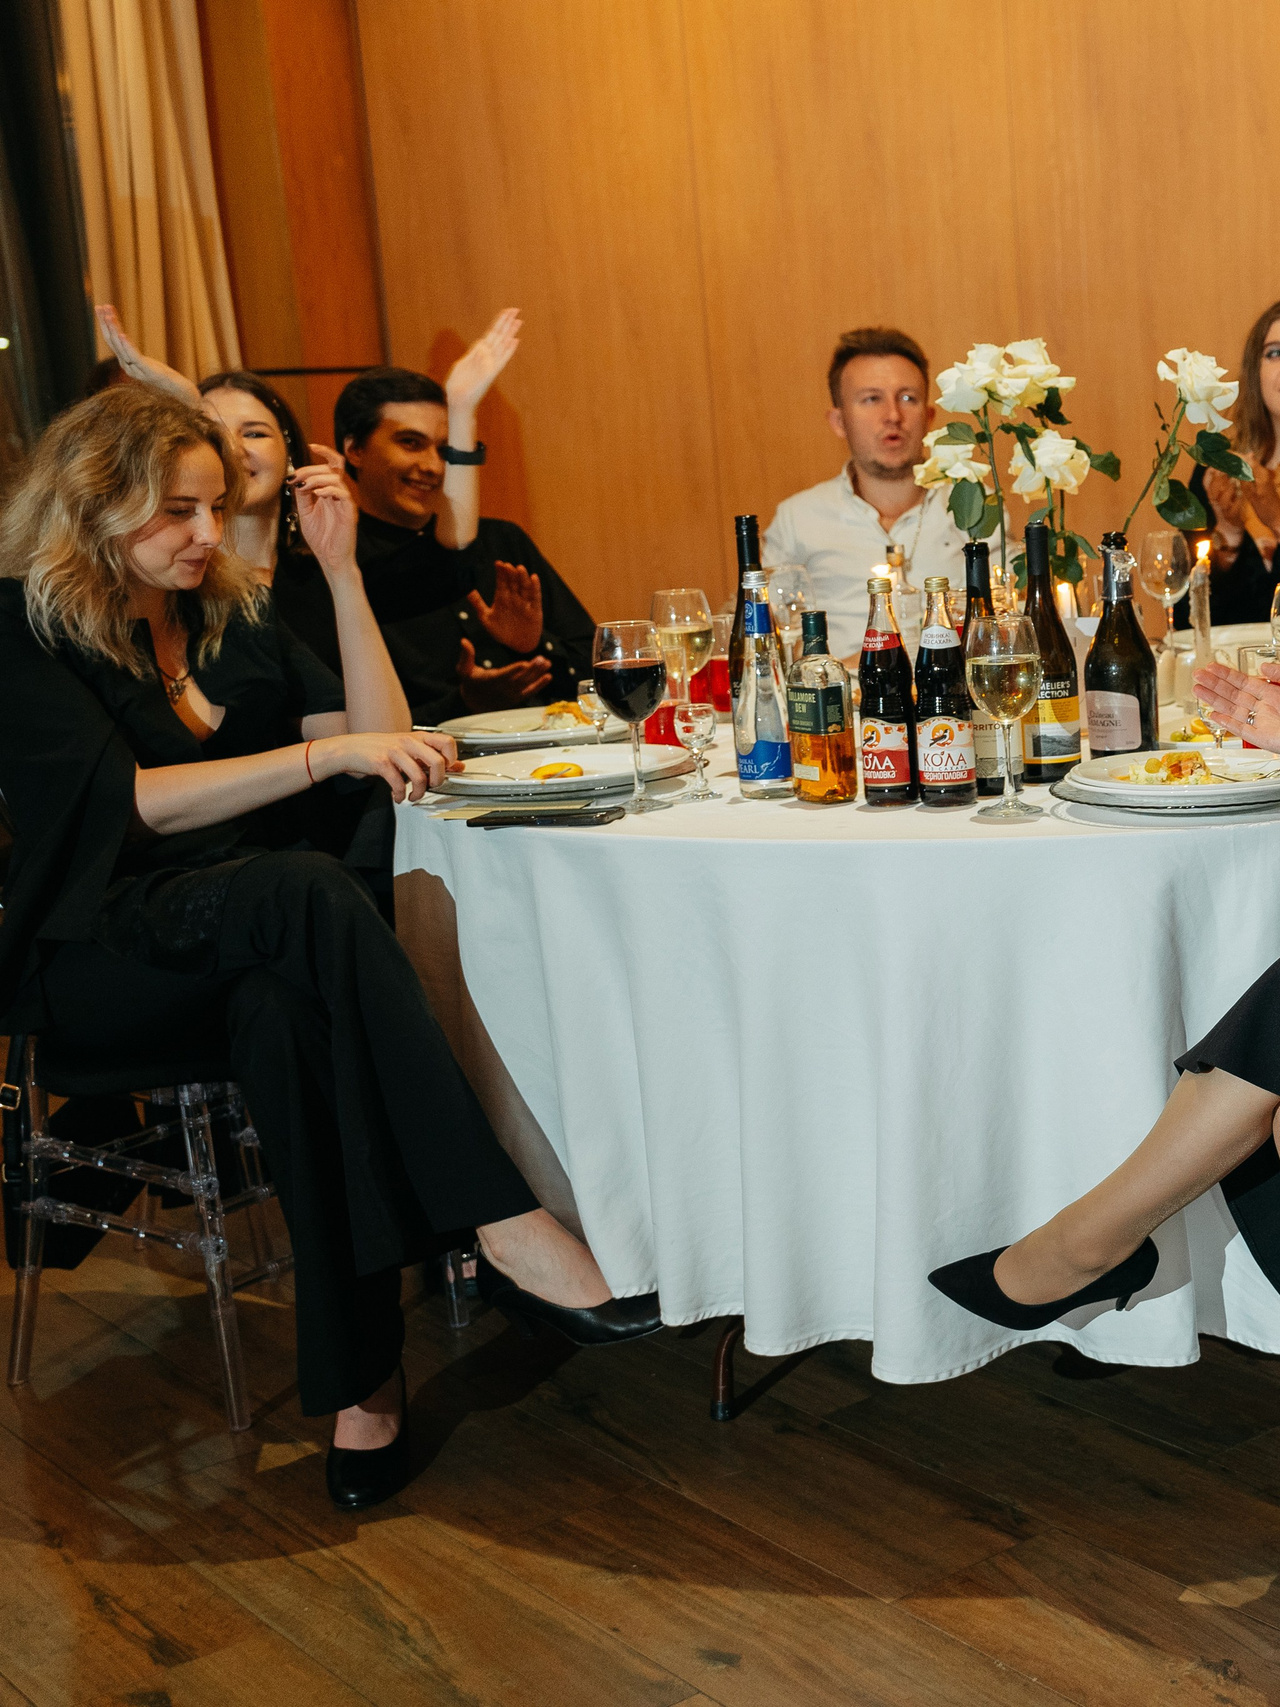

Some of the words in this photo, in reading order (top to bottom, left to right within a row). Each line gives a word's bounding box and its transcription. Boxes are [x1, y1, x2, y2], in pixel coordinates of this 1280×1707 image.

[1040, 681, 1070, 690] MELIER'S
[1037, 690, 1069, 699] LECTION
[863, 754, 895, 770] ОЛА
